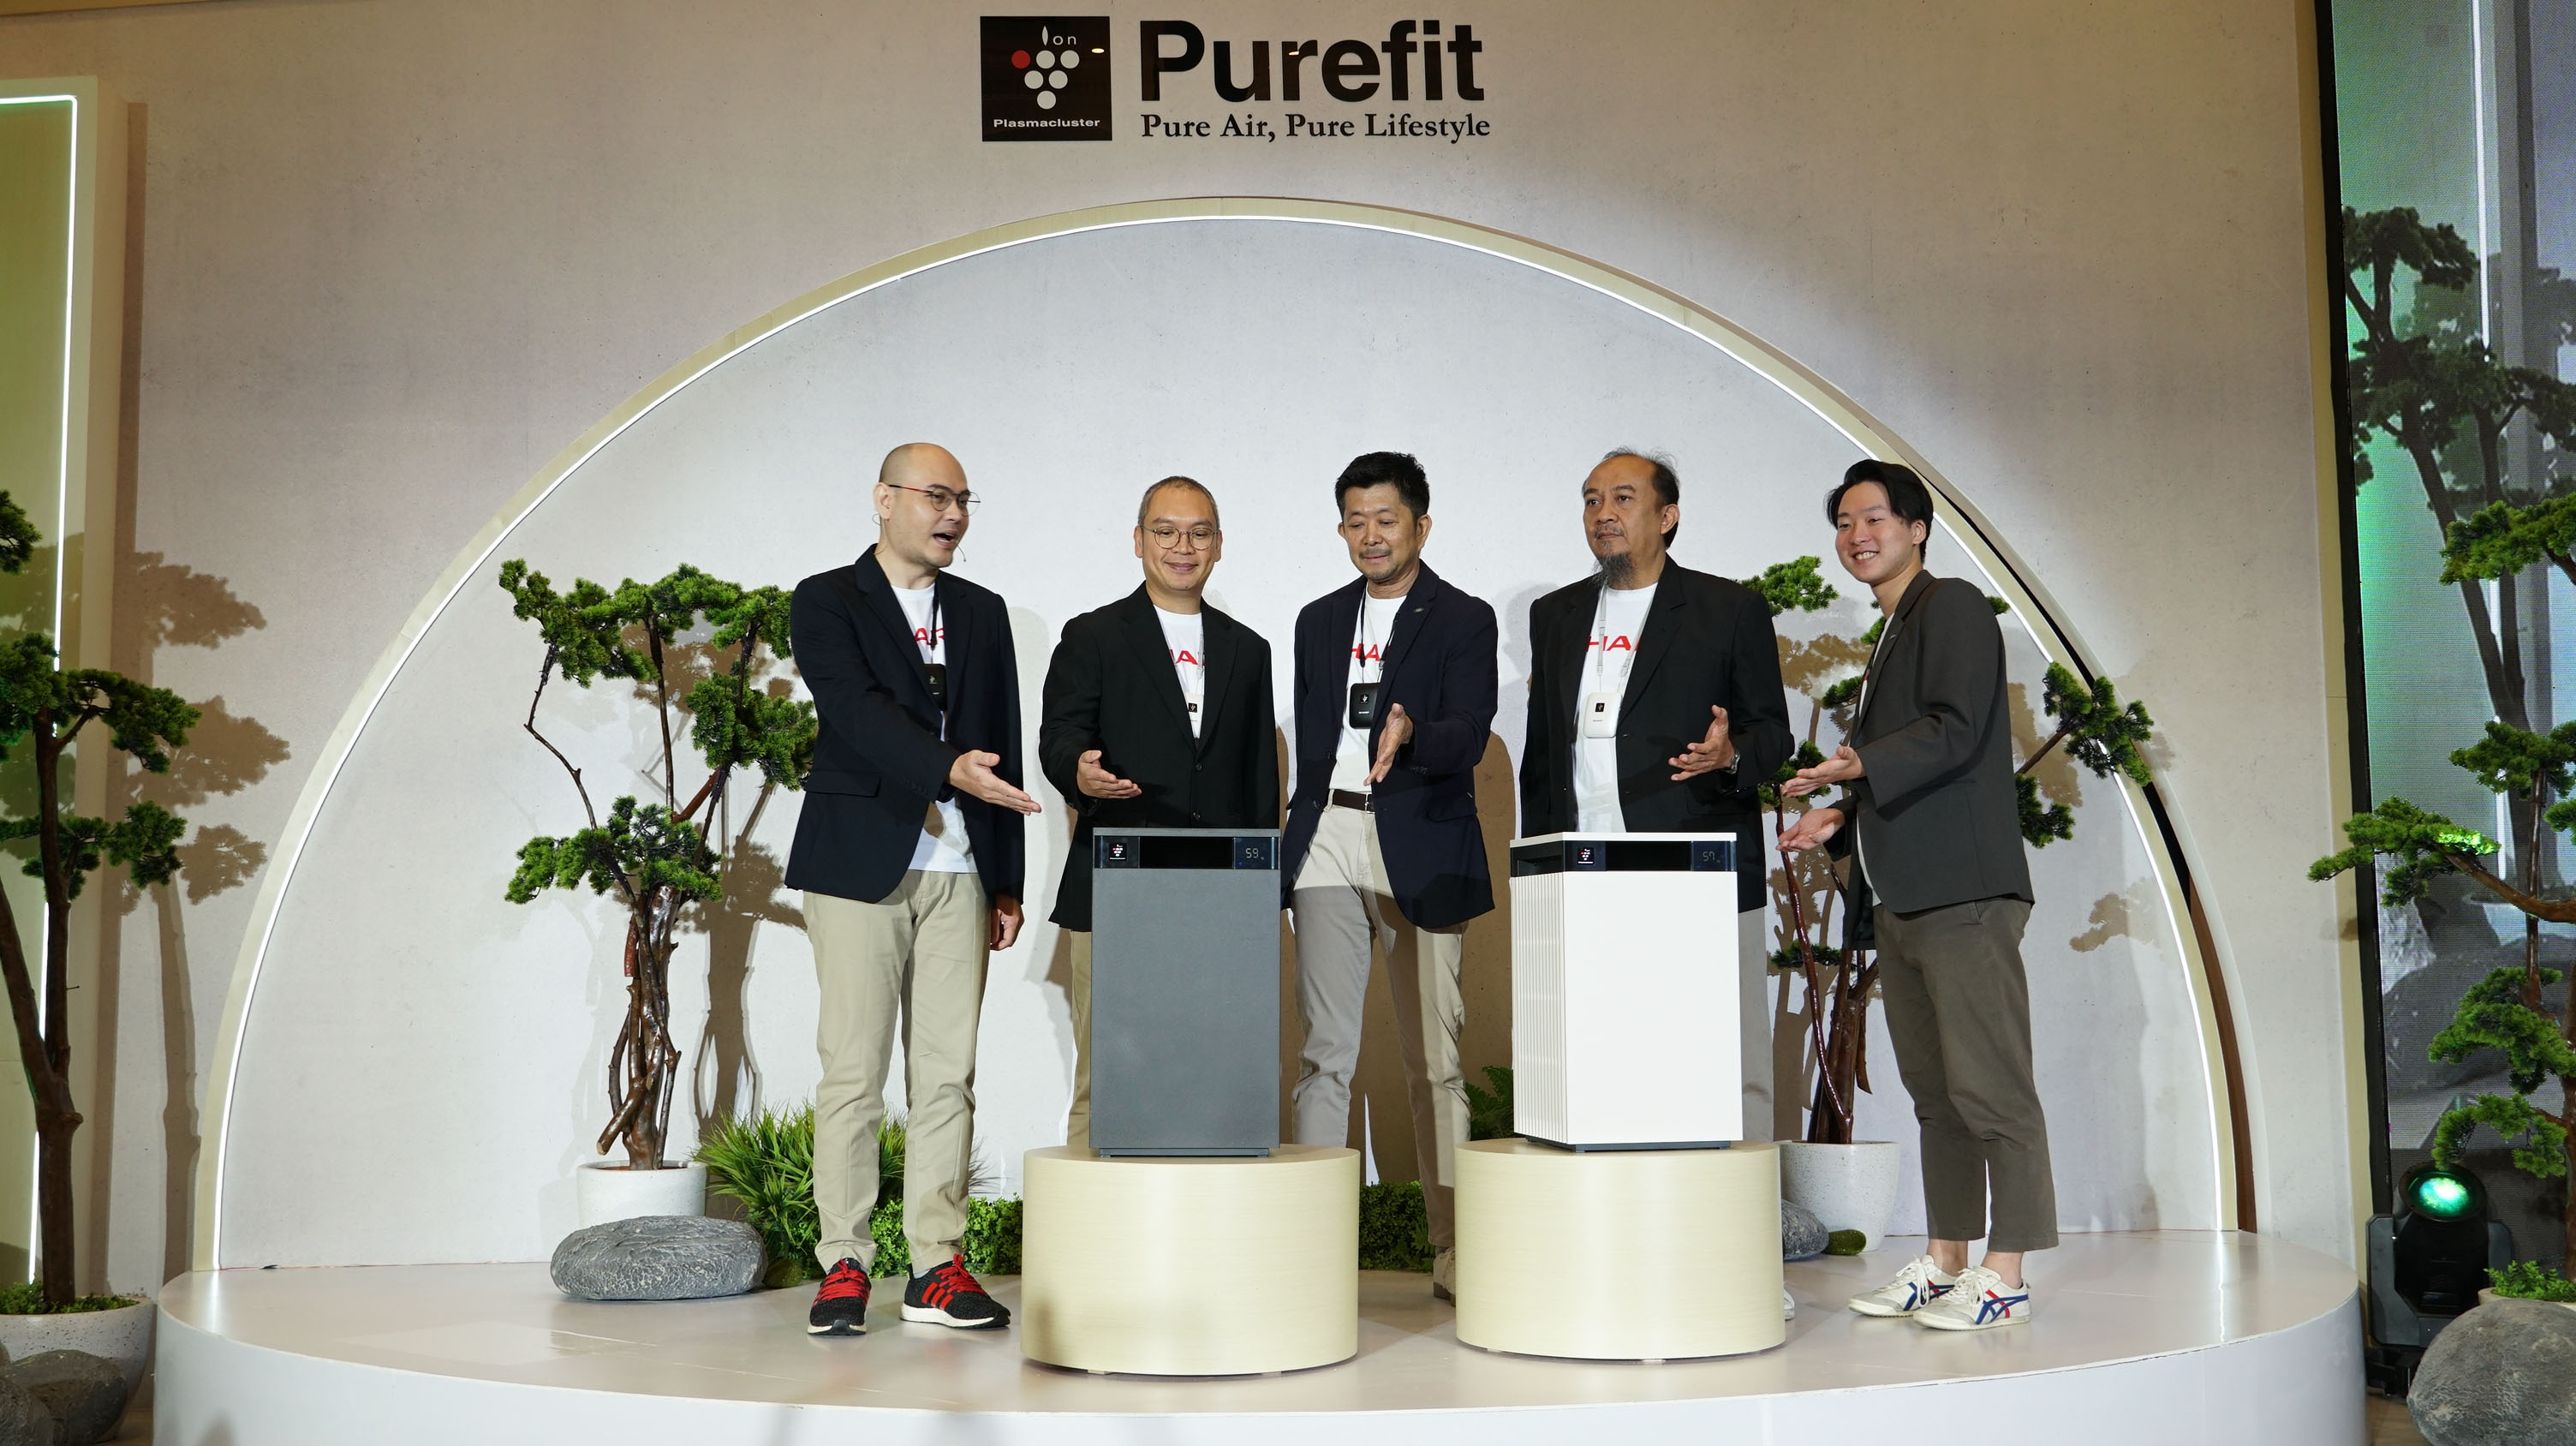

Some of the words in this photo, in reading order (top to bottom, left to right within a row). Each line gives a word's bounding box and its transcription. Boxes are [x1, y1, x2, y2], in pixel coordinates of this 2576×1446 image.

[1140, 20, 1485, 102] Purefit
[993, 118, 1101, 128] Plasmacluster
[1141, 113, 1211, 137] Pure
[1220, 113, 1276, 143] Air,
[1285, 113, 1355, 137] Pure
[1365, 112, 1491, 145] Lifestyle
[1245, 847, 1259, 858] 59
